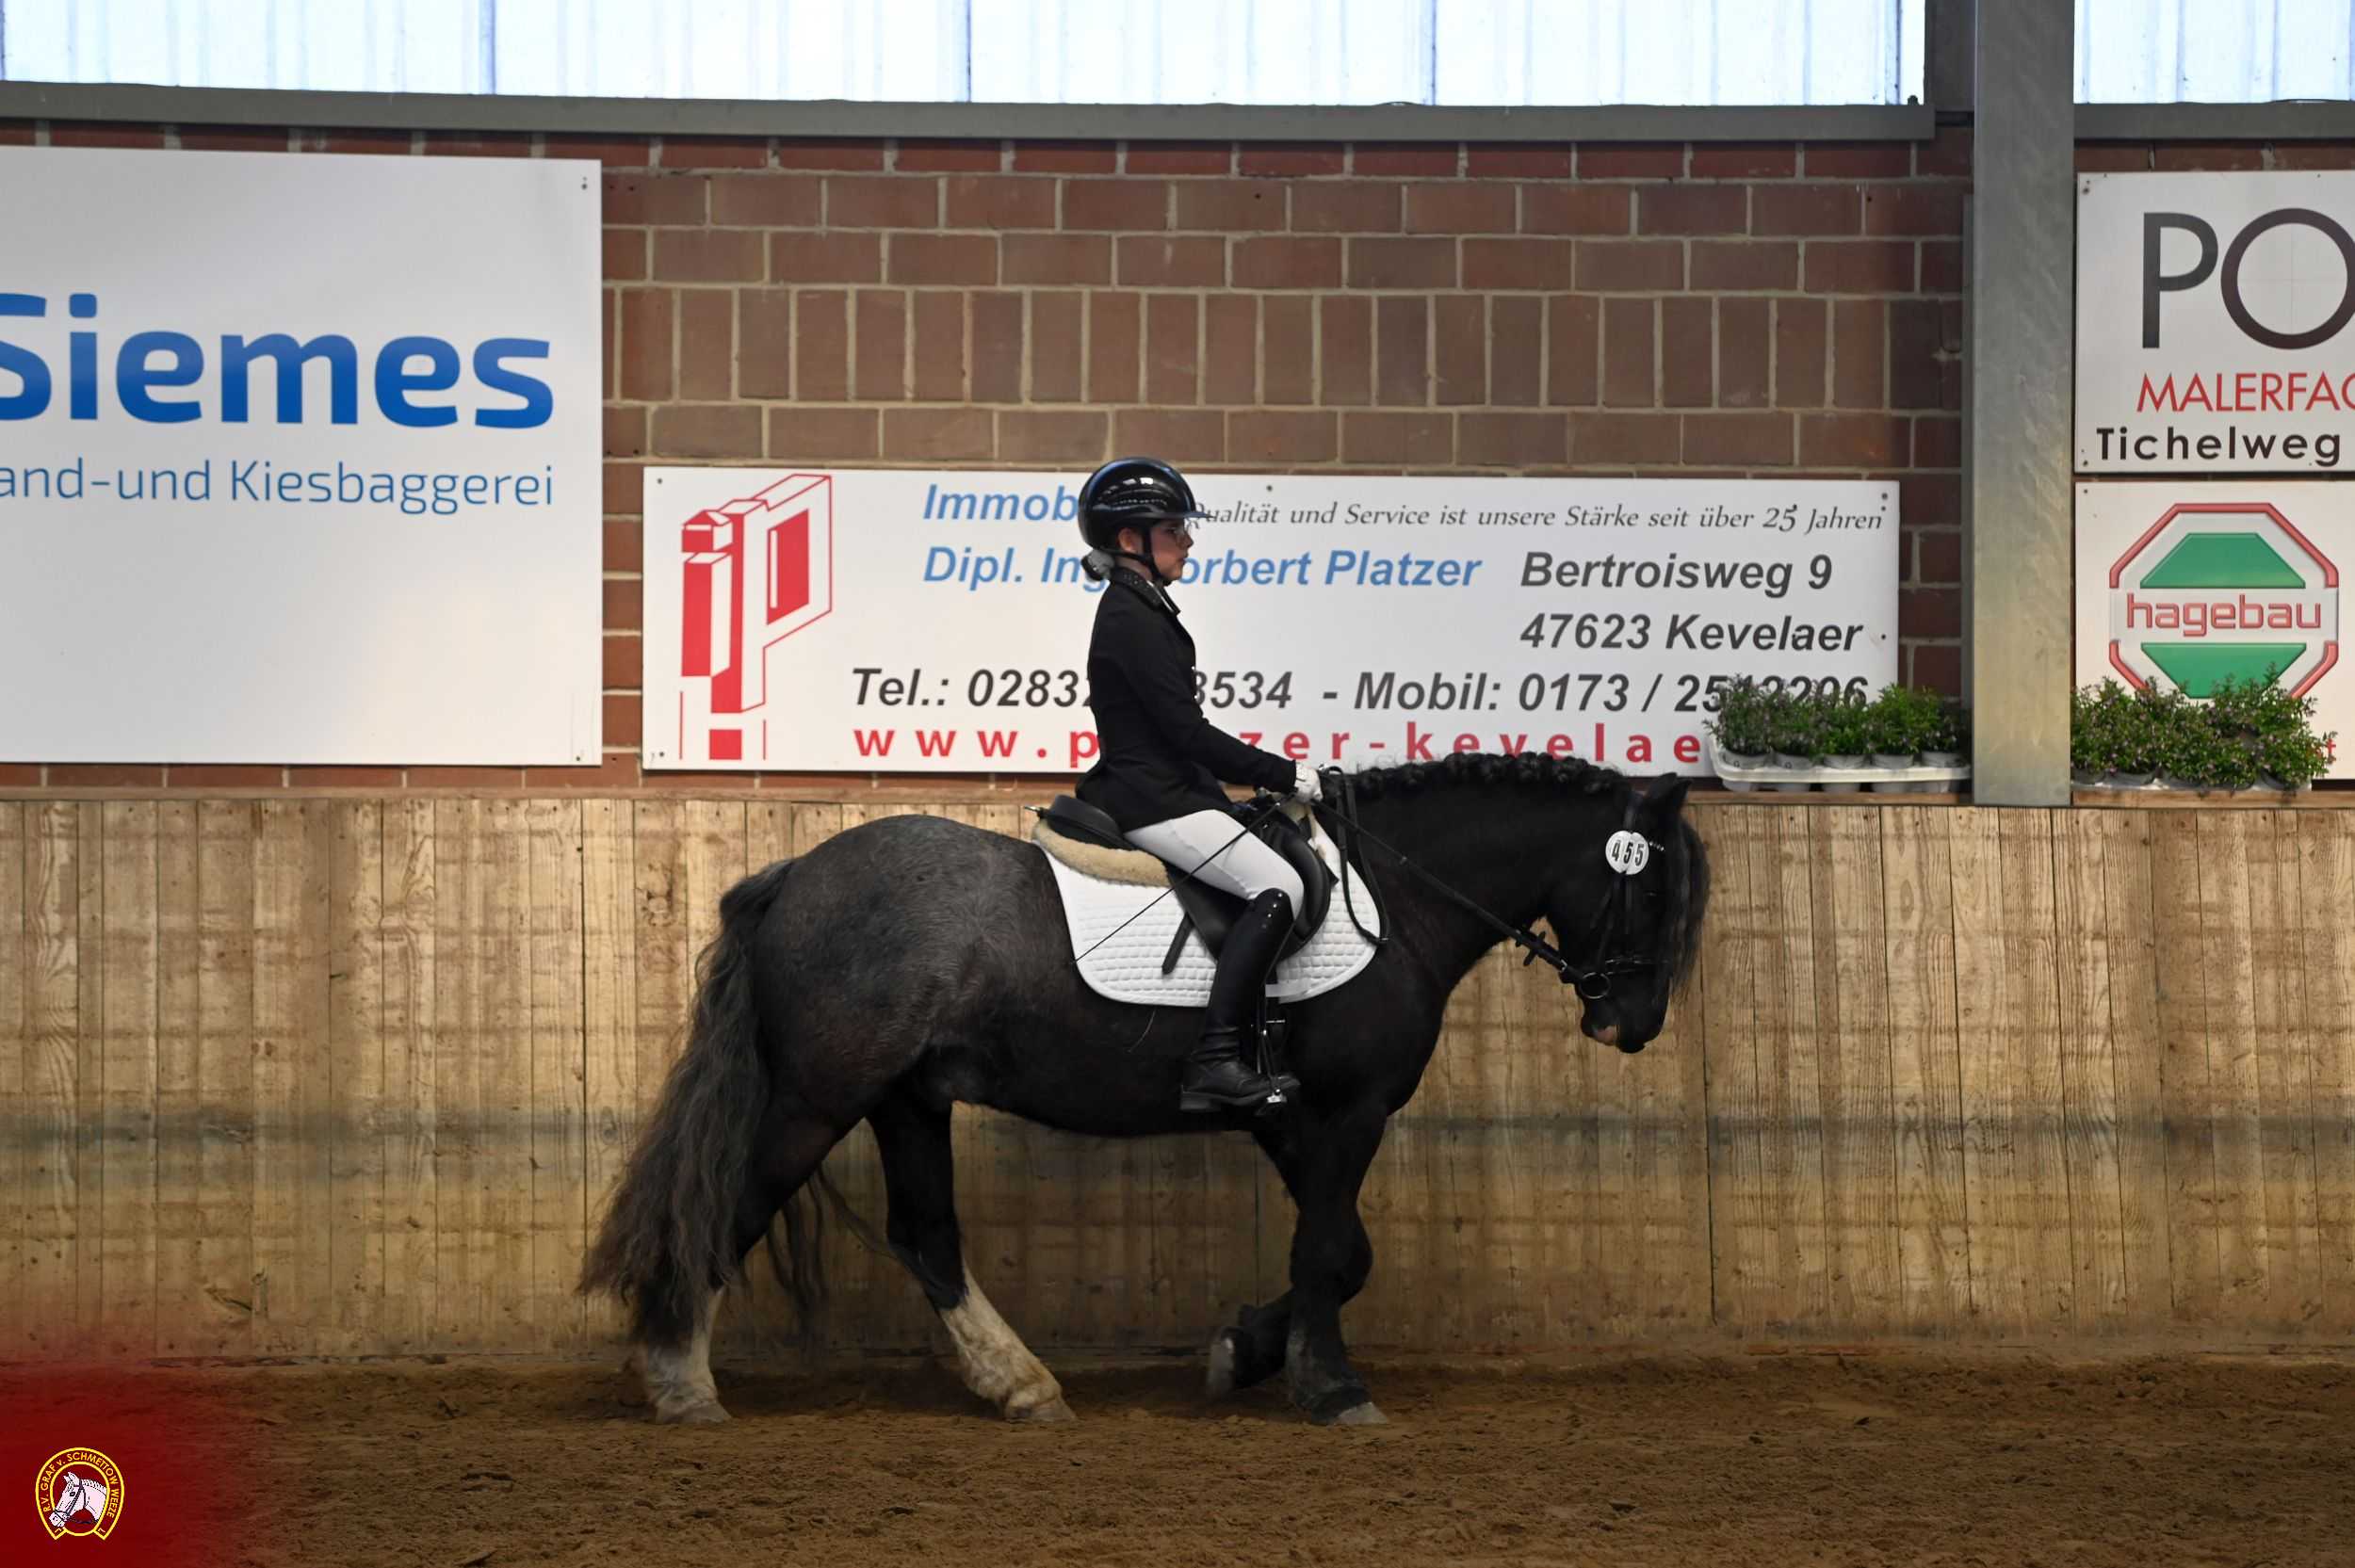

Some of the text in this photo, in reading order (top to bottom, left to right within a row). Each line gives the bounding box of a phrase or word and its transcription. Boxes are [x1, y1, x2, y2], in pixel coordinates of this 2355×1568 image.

[2096, 426, 2341, 467] Tichelweg
[231, 460, 552, 515] Kiesbaggerei
[923, 483, 1079, 521] Immob
[1291, 501, 1340, 524] und
[1345, 504, 1430, 525] Service
[1439, 506, 1468, 525] ist
[1478, 510, 1556, 526] unsere
[1565, 504, 1639, 527] Stärke
[1648, 509, 1689, 527] seit
[1699, 506, 1755, 527] über
[1762, 504, 1797, 532] 25
[1805, 506, 1882, 535] Jahren
[923, 546, 1022, 591] Dipl.
[1179, 549, 1312, 586] orbert
[1324, 549, 1484, 587] Platzer
[1520, 552, 1833, 598] Bertroisweg 9
[1520, 613, 1864, 651] 47623 Kevelaer
[2126, 593, 2322, 637] hagebau
[853, 668, 950, 706] Tel.:
[1323, 691, 1339, 700] -
[1354, 671, 1502, 711] Mobil:
[1519, 672, 1630, 712] 0173
[1641, 672, 1665, 713] /
[1612, 840, 1644, 866] 455
